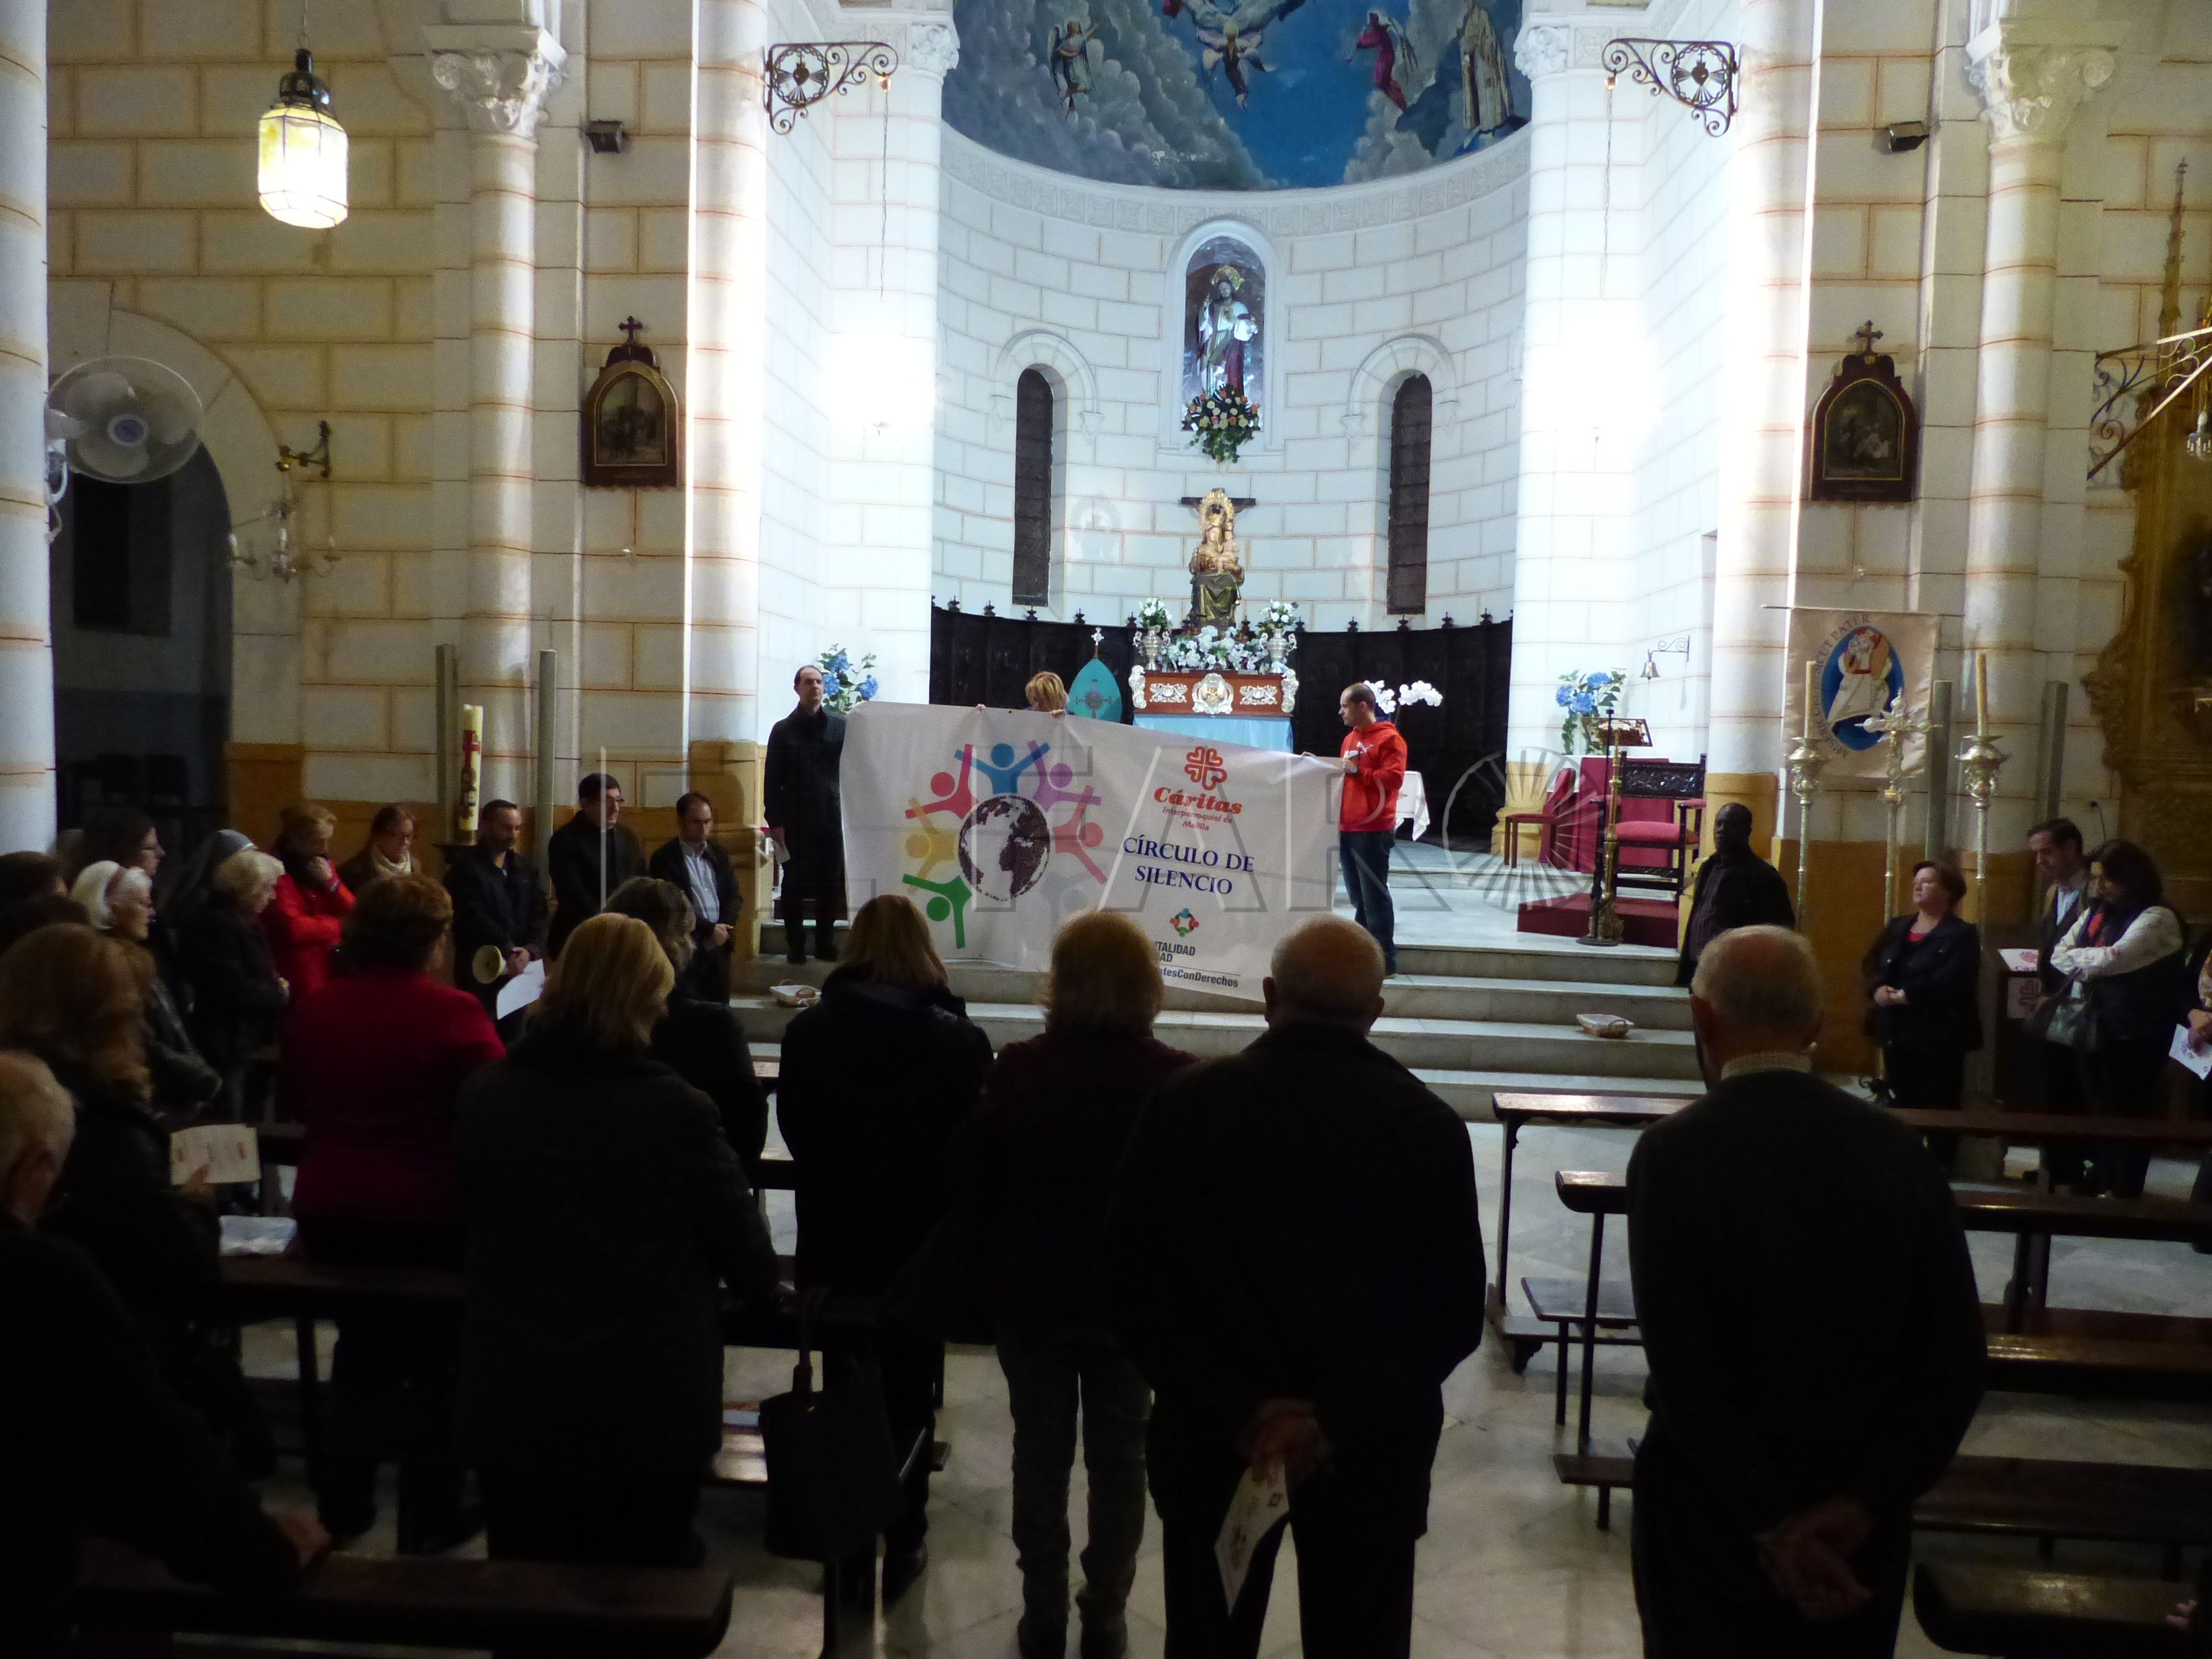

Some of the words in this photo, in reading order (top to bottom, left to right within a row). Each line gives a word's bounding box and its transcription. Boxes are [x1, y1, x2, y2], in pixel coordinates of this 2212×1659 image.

[1830, 613, 1870, 640] PATER
[1154, 786, 1243, 815] Cáritas
[1163, 806, 1222, 822] Interparroquial
[1223, 815, 1233, 824] de
[1183, 820, 1209, 831] Melilla
[1123, 834, 1218, 866] CÍRCULO
[1225, 853, 1255, 873] DE
[1134, 865, 1233, 895] SILENCIO
[1161, 967, 1239, 988] tesConDerechos
